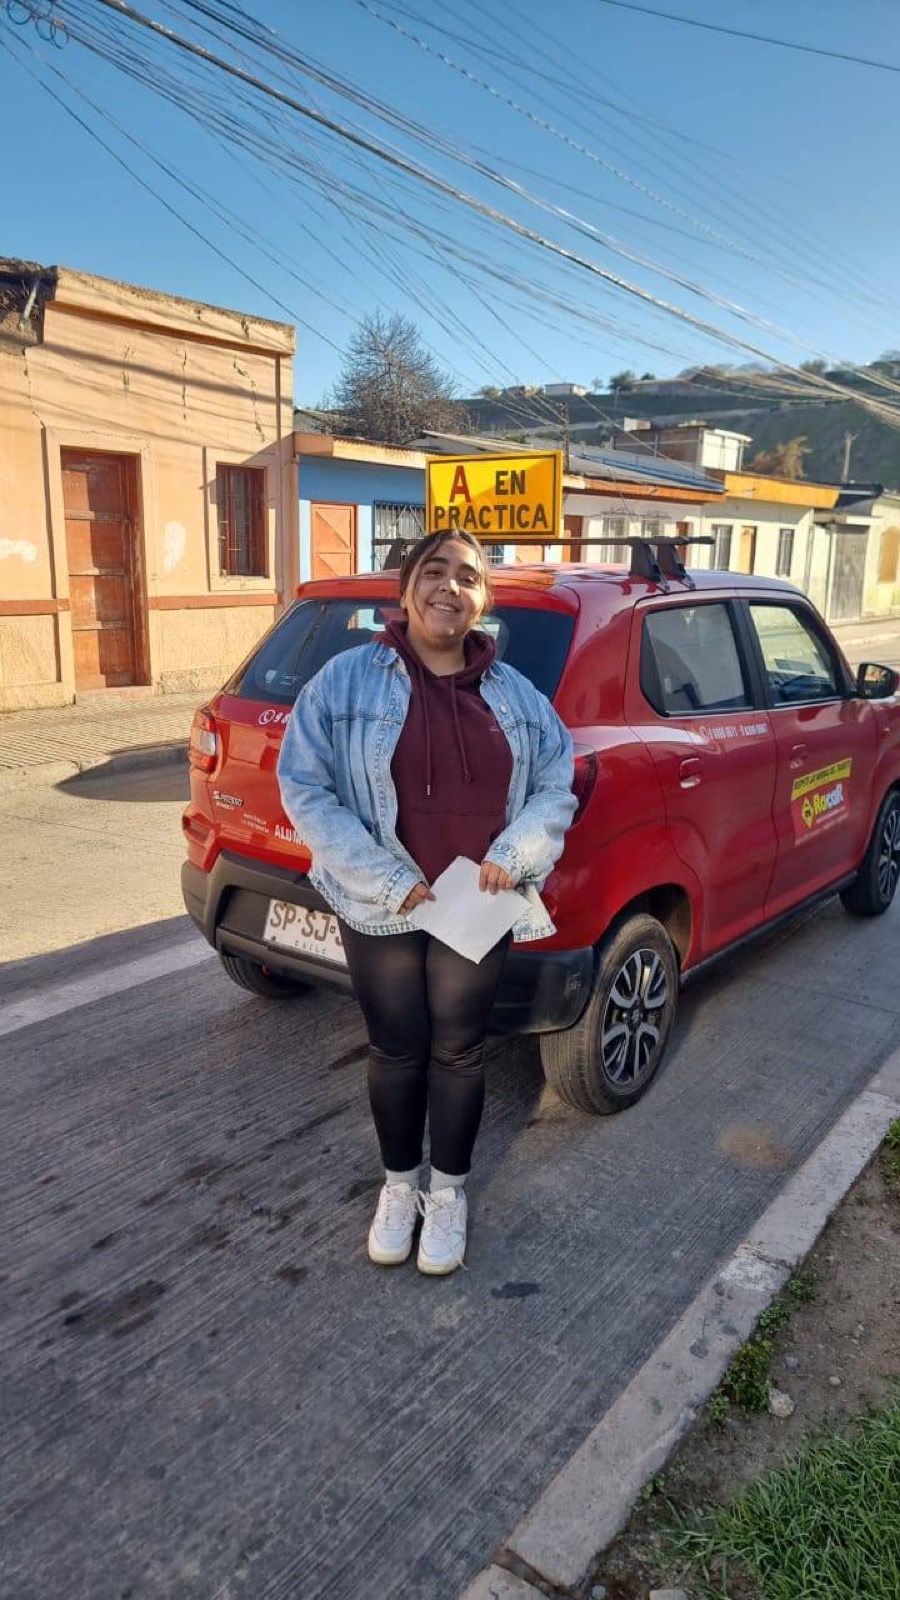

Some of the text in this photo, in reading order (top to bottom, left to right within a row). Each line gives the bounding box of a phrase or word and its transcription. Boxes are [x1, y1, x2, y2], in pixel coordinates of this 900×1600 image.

[449, 465, 526, 503] A EN
[434, 503, 549, 530] PRACTICA
